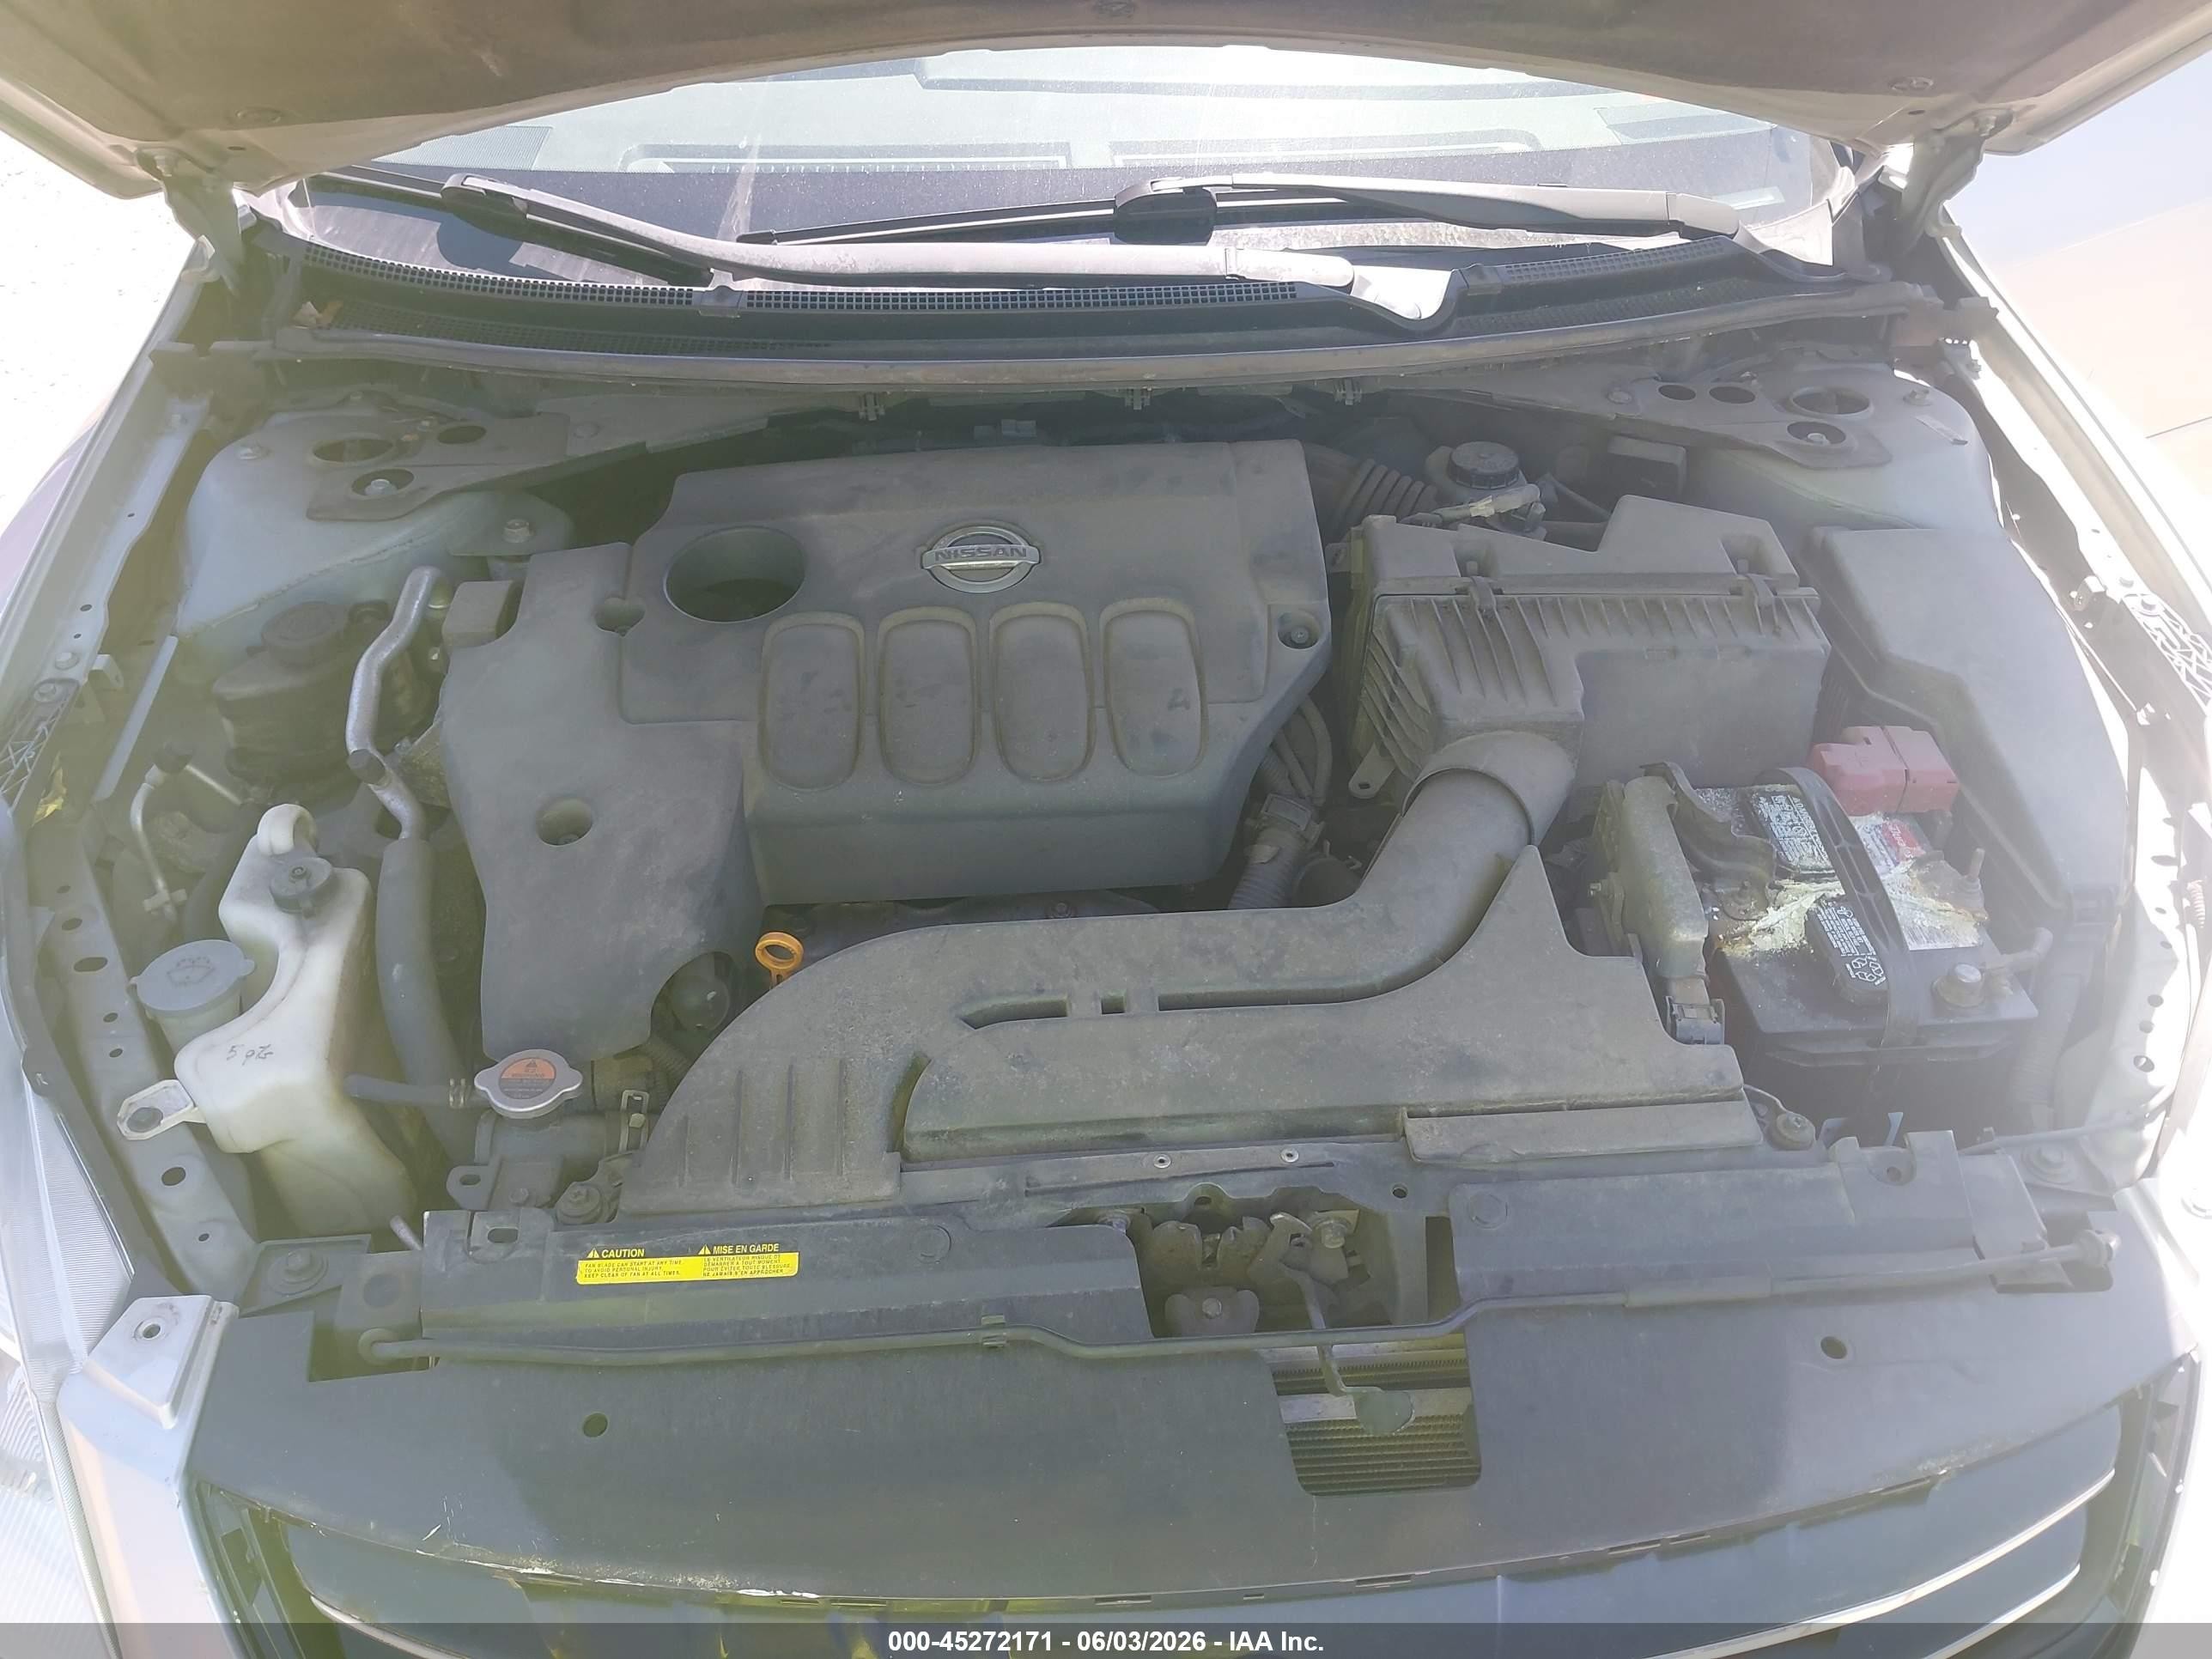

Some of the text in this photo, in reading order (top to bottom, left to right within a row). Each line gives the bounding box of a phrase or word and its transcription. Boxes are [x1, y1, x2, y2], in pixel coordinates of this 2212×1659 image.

[934, 547, 1028, 562] NISSAN
[601, 1249, 645, 1259] CAUTION
[713, 1243, 780, 1255] MISE EN GARDE
